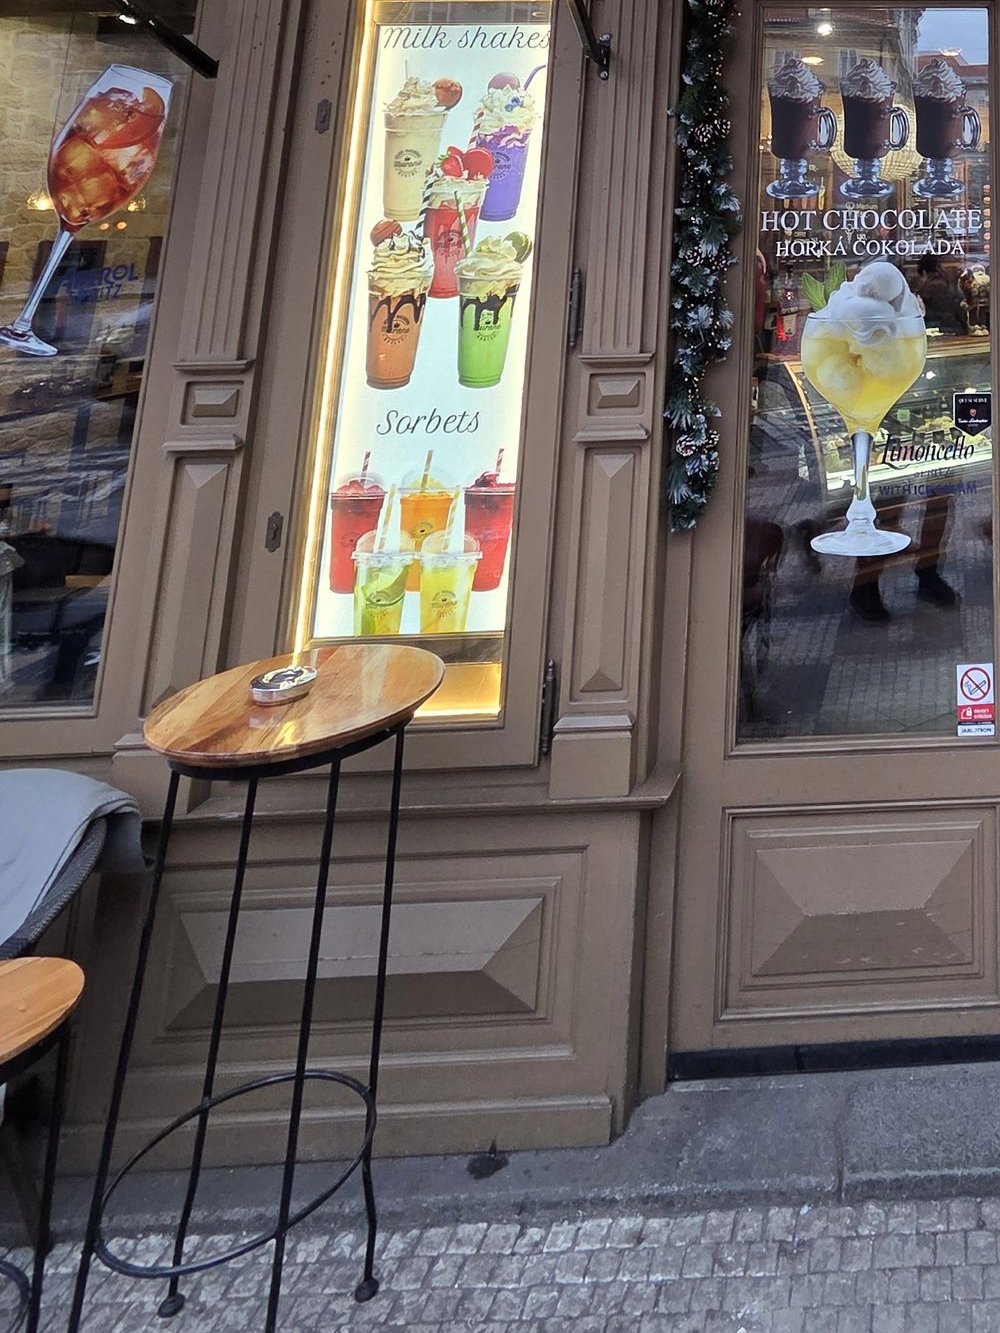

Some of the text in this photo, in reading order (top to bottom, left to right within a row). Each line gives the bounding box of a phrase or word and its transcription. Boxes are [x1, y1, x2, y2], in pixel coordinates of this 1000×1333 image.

[456, 25, 551, 49] shakes
[760, 208, 984, 232] HOT CHOCOLATE
[775, 236, 848, 257] HORKÁ
[376, 408, 480, 435] Sorbets
[881, 434, 976, 470] Limoncello
